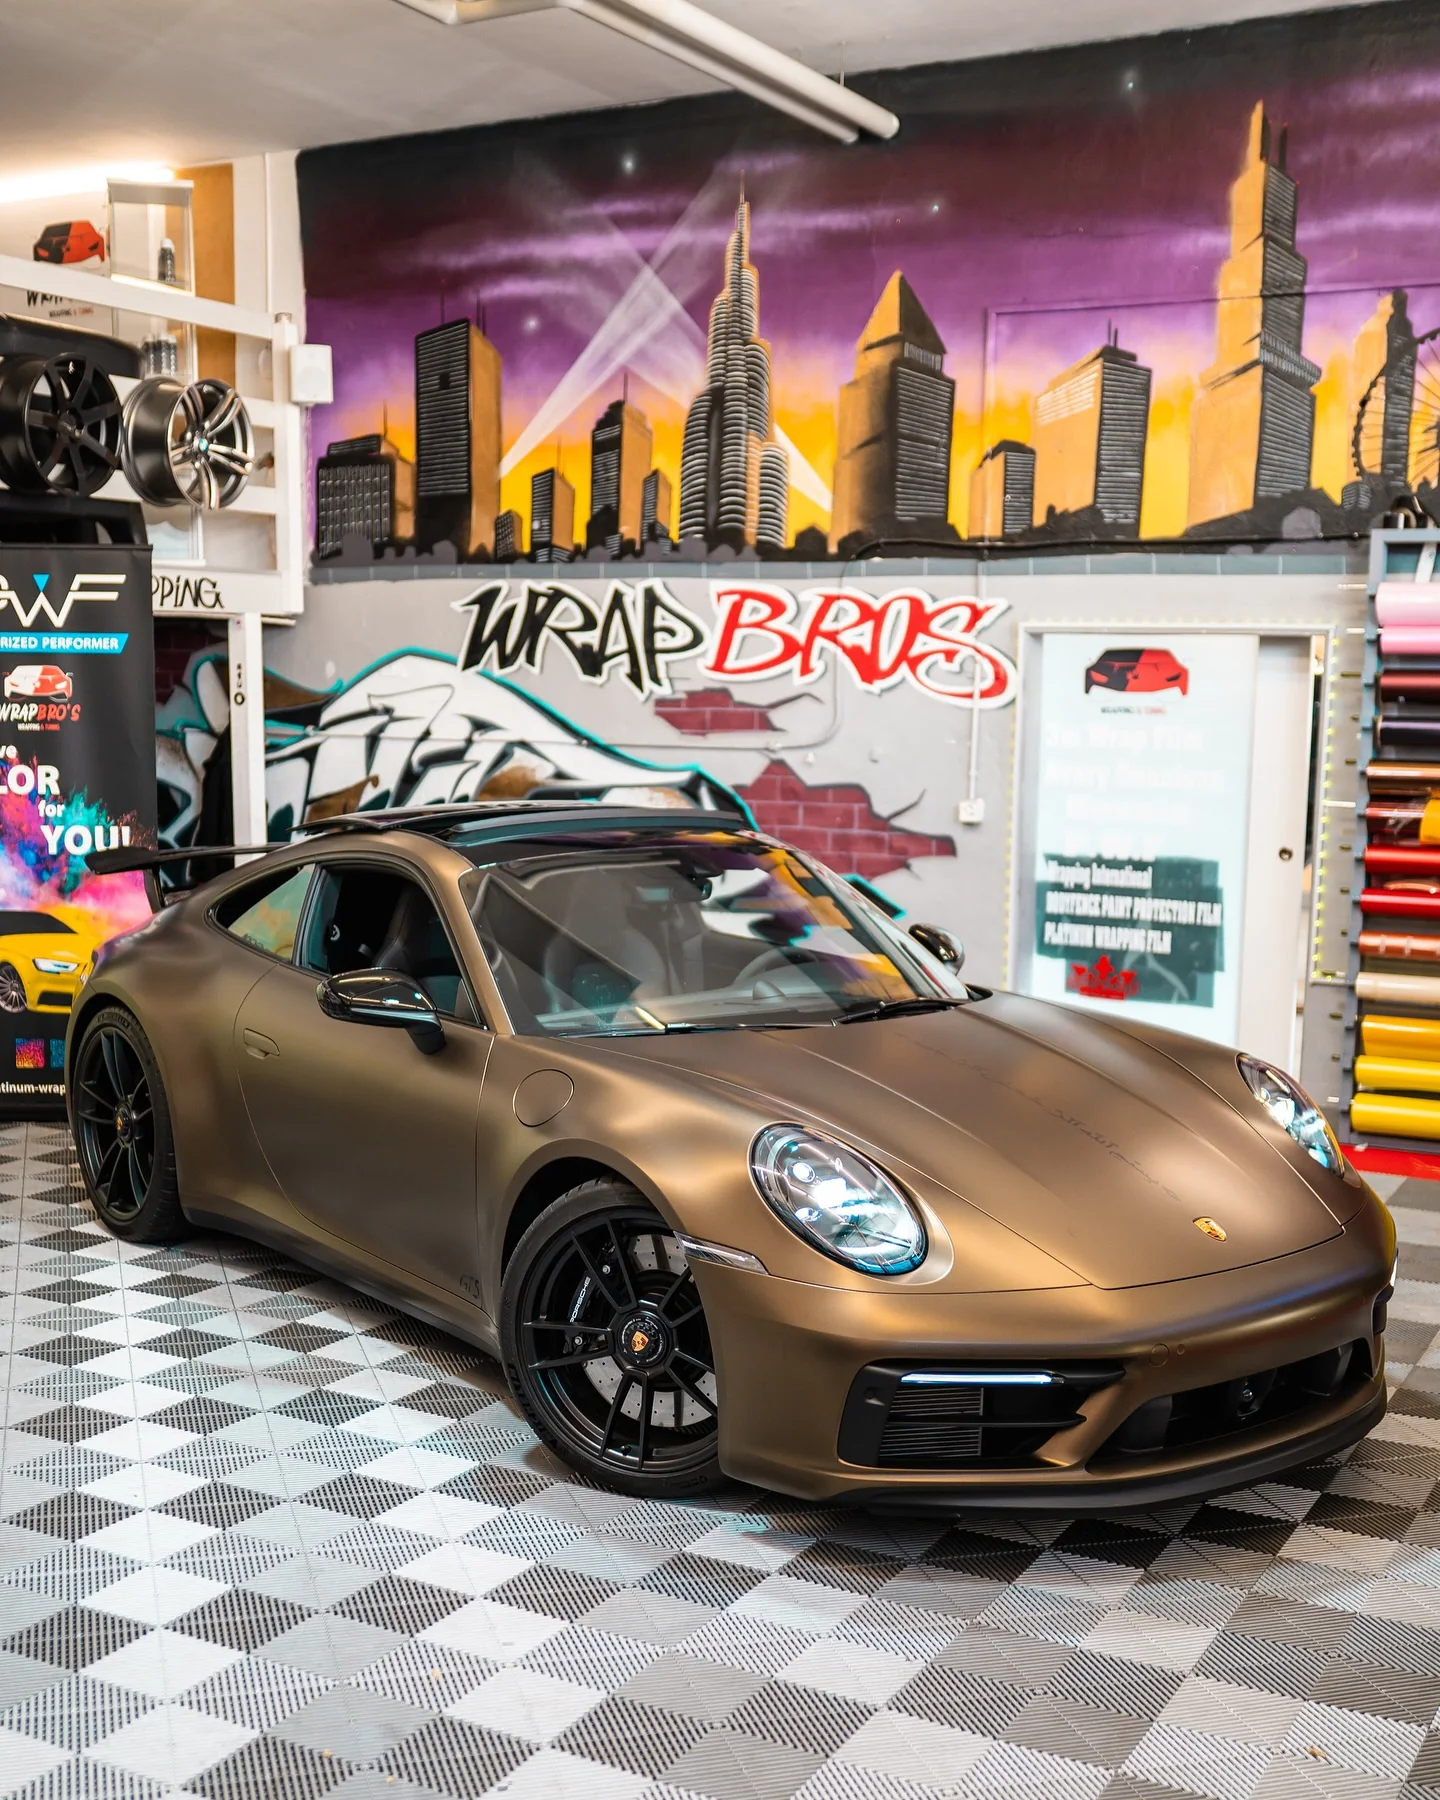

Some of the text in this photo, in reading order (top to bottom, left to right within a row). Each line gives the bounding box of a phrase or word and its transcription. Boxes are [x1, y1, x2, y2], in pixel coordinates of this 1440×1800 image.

[42, 637, 119, 650] PERFORMER
[456, 581, 1012, 700] WRAP BROS
[38, 799, 65, 817] for
[0, 1082, 66, 1096] tinum-wrap
